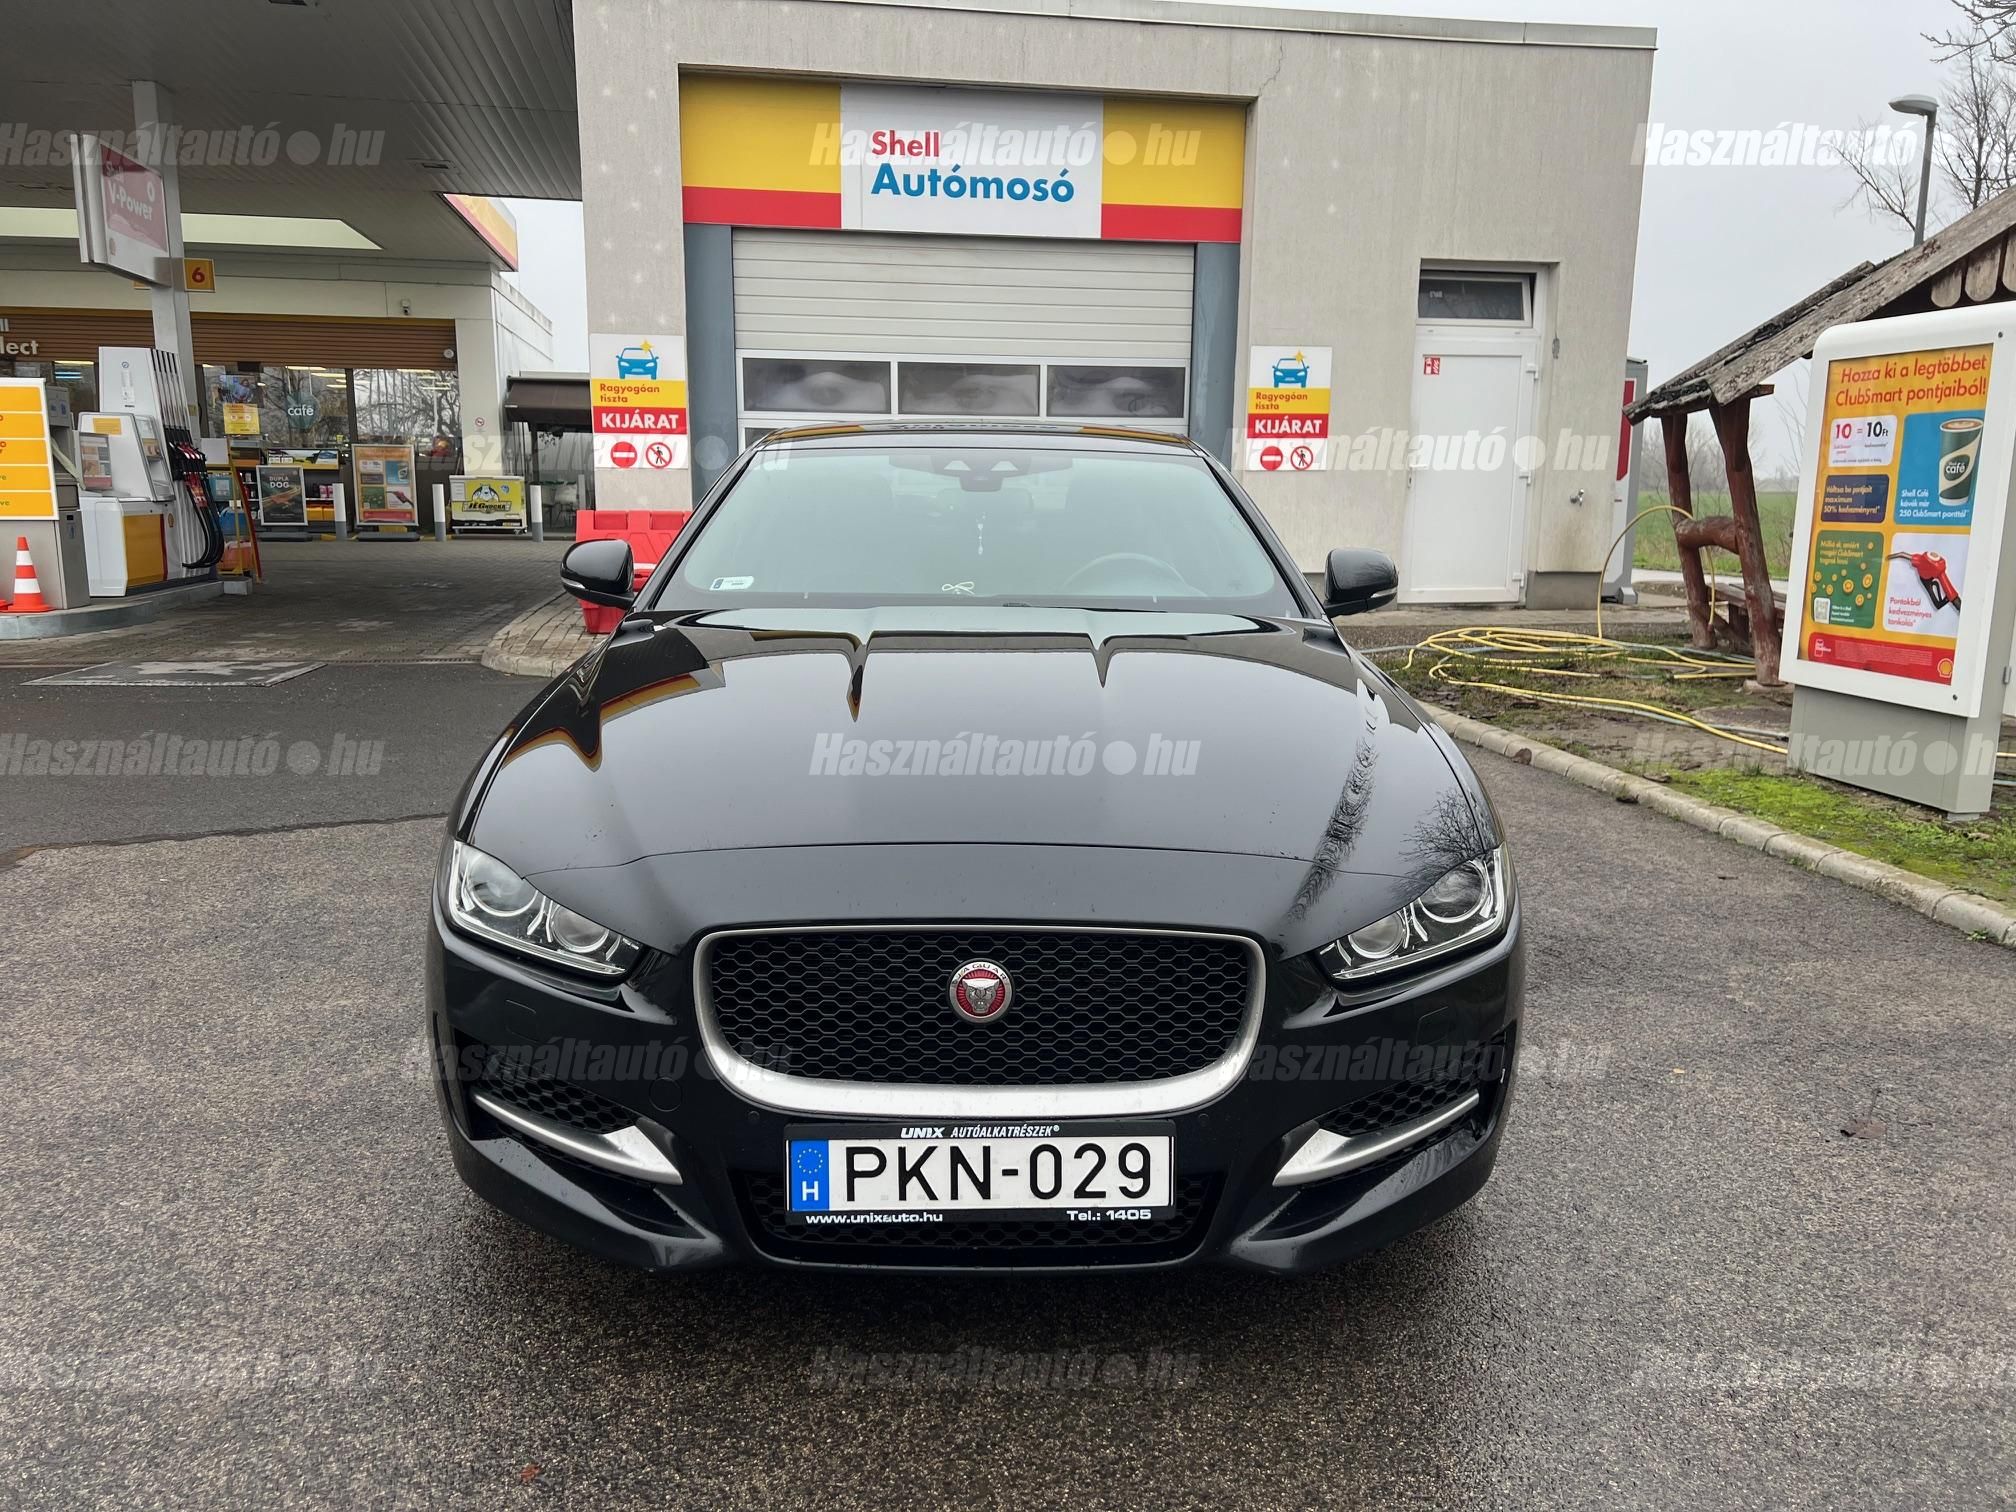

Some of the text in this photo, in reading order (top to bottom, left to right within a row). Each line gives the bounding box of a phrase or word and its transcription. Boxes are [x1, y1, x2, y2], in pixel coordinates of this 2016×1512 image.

[871, 130, 940, 157] Shell
[871, 163, 1074, 202] Autómosó
[192, 267, 205, 283] 6
[1841, 352, 1987, 384] Hozza ki a legtöbbet
[600, 383, 660, 395] Ragyogóan
[1835, 376, 1987, 407] ClubSmart pontjaiból!
[600, 394, 628, 403] tiszta
[1256, 391, 1308, 402] Ragyogóan
[287, 403, 315, 416] café
[1255, 401, 1280, 411] tiszta
[601, 409, 679, 430] KIJÁRAT
[1254, 415, 1323, 434] KIJÁRAT
[1835, 423, 1852, 439] 10
[1945, 462, 1966, 474] café
[269, 481, 290, 489] DOG
[1901, 489, 1916, 497] Shell
[1899, 509, 1912, 518] 250
[901, 1127, 945, 1138] UNIX
[845, 1142, 1151, 1202] PKN-029
[802, 1181, 819, 1201] H
[806, 1212, 943, 1224] www.unixauto.hu
[1066, 1209, 1152, 1221] Tel.: 1405
